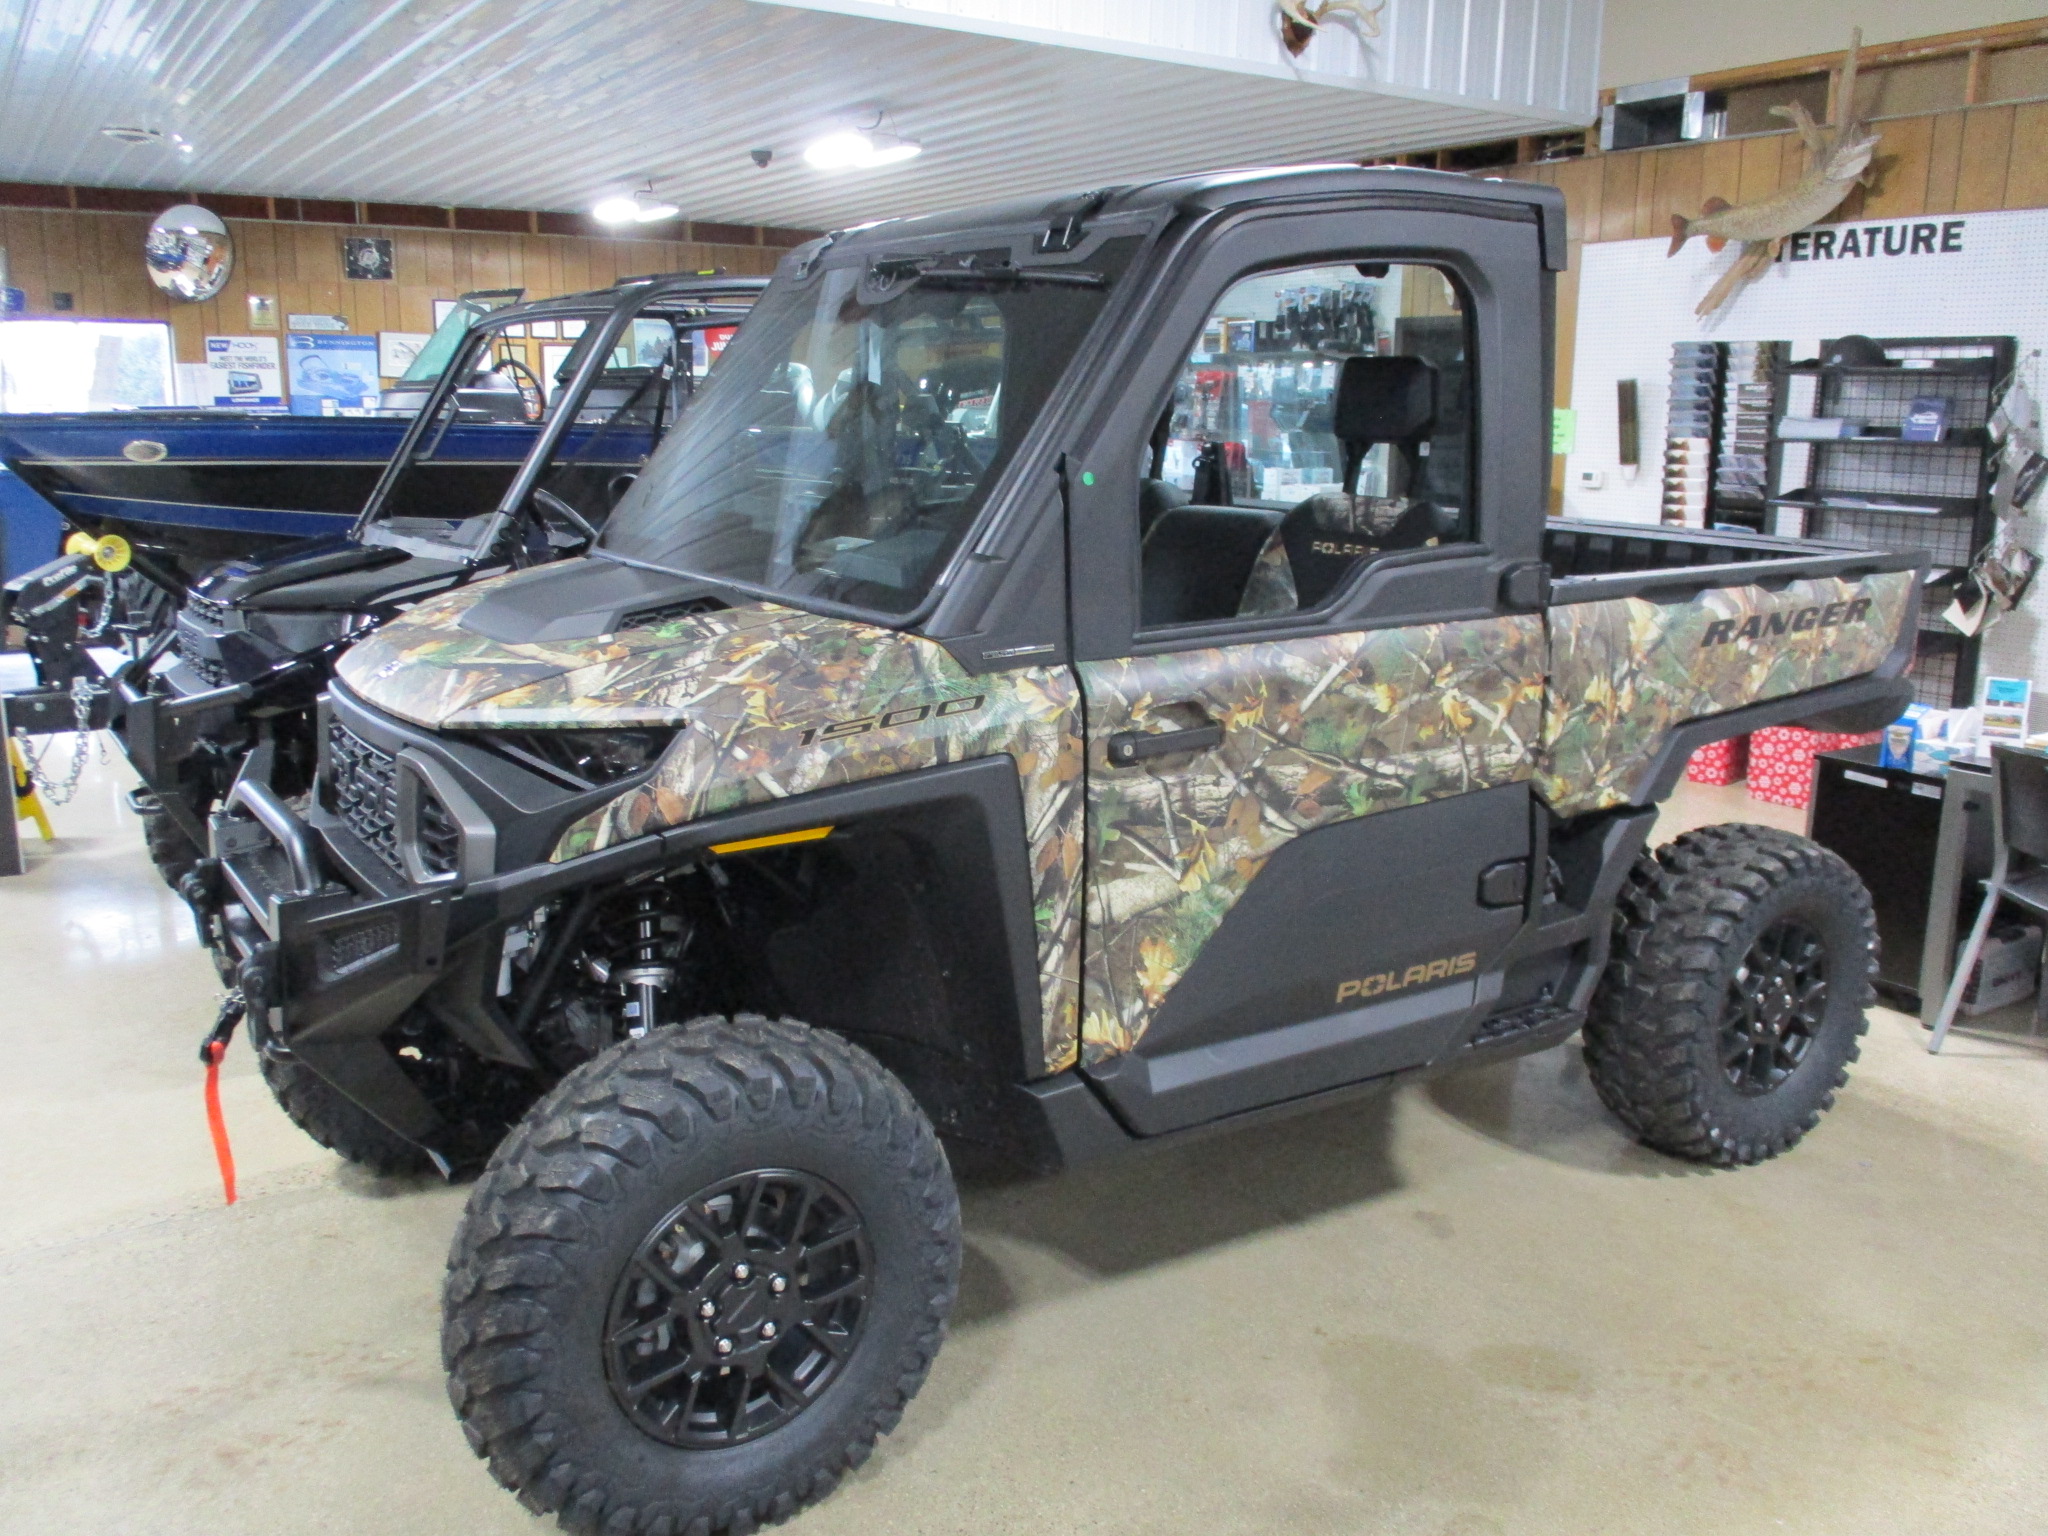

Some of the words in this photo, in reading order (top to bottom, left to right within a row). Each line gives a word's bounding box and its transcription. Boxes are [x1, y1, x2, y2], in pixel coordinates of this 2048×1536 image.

[1701, 597, 1873, 648] RANGER
[800, 695, 986, 747] 1500
[1336, 951, 1478, 1004] POLARIS
